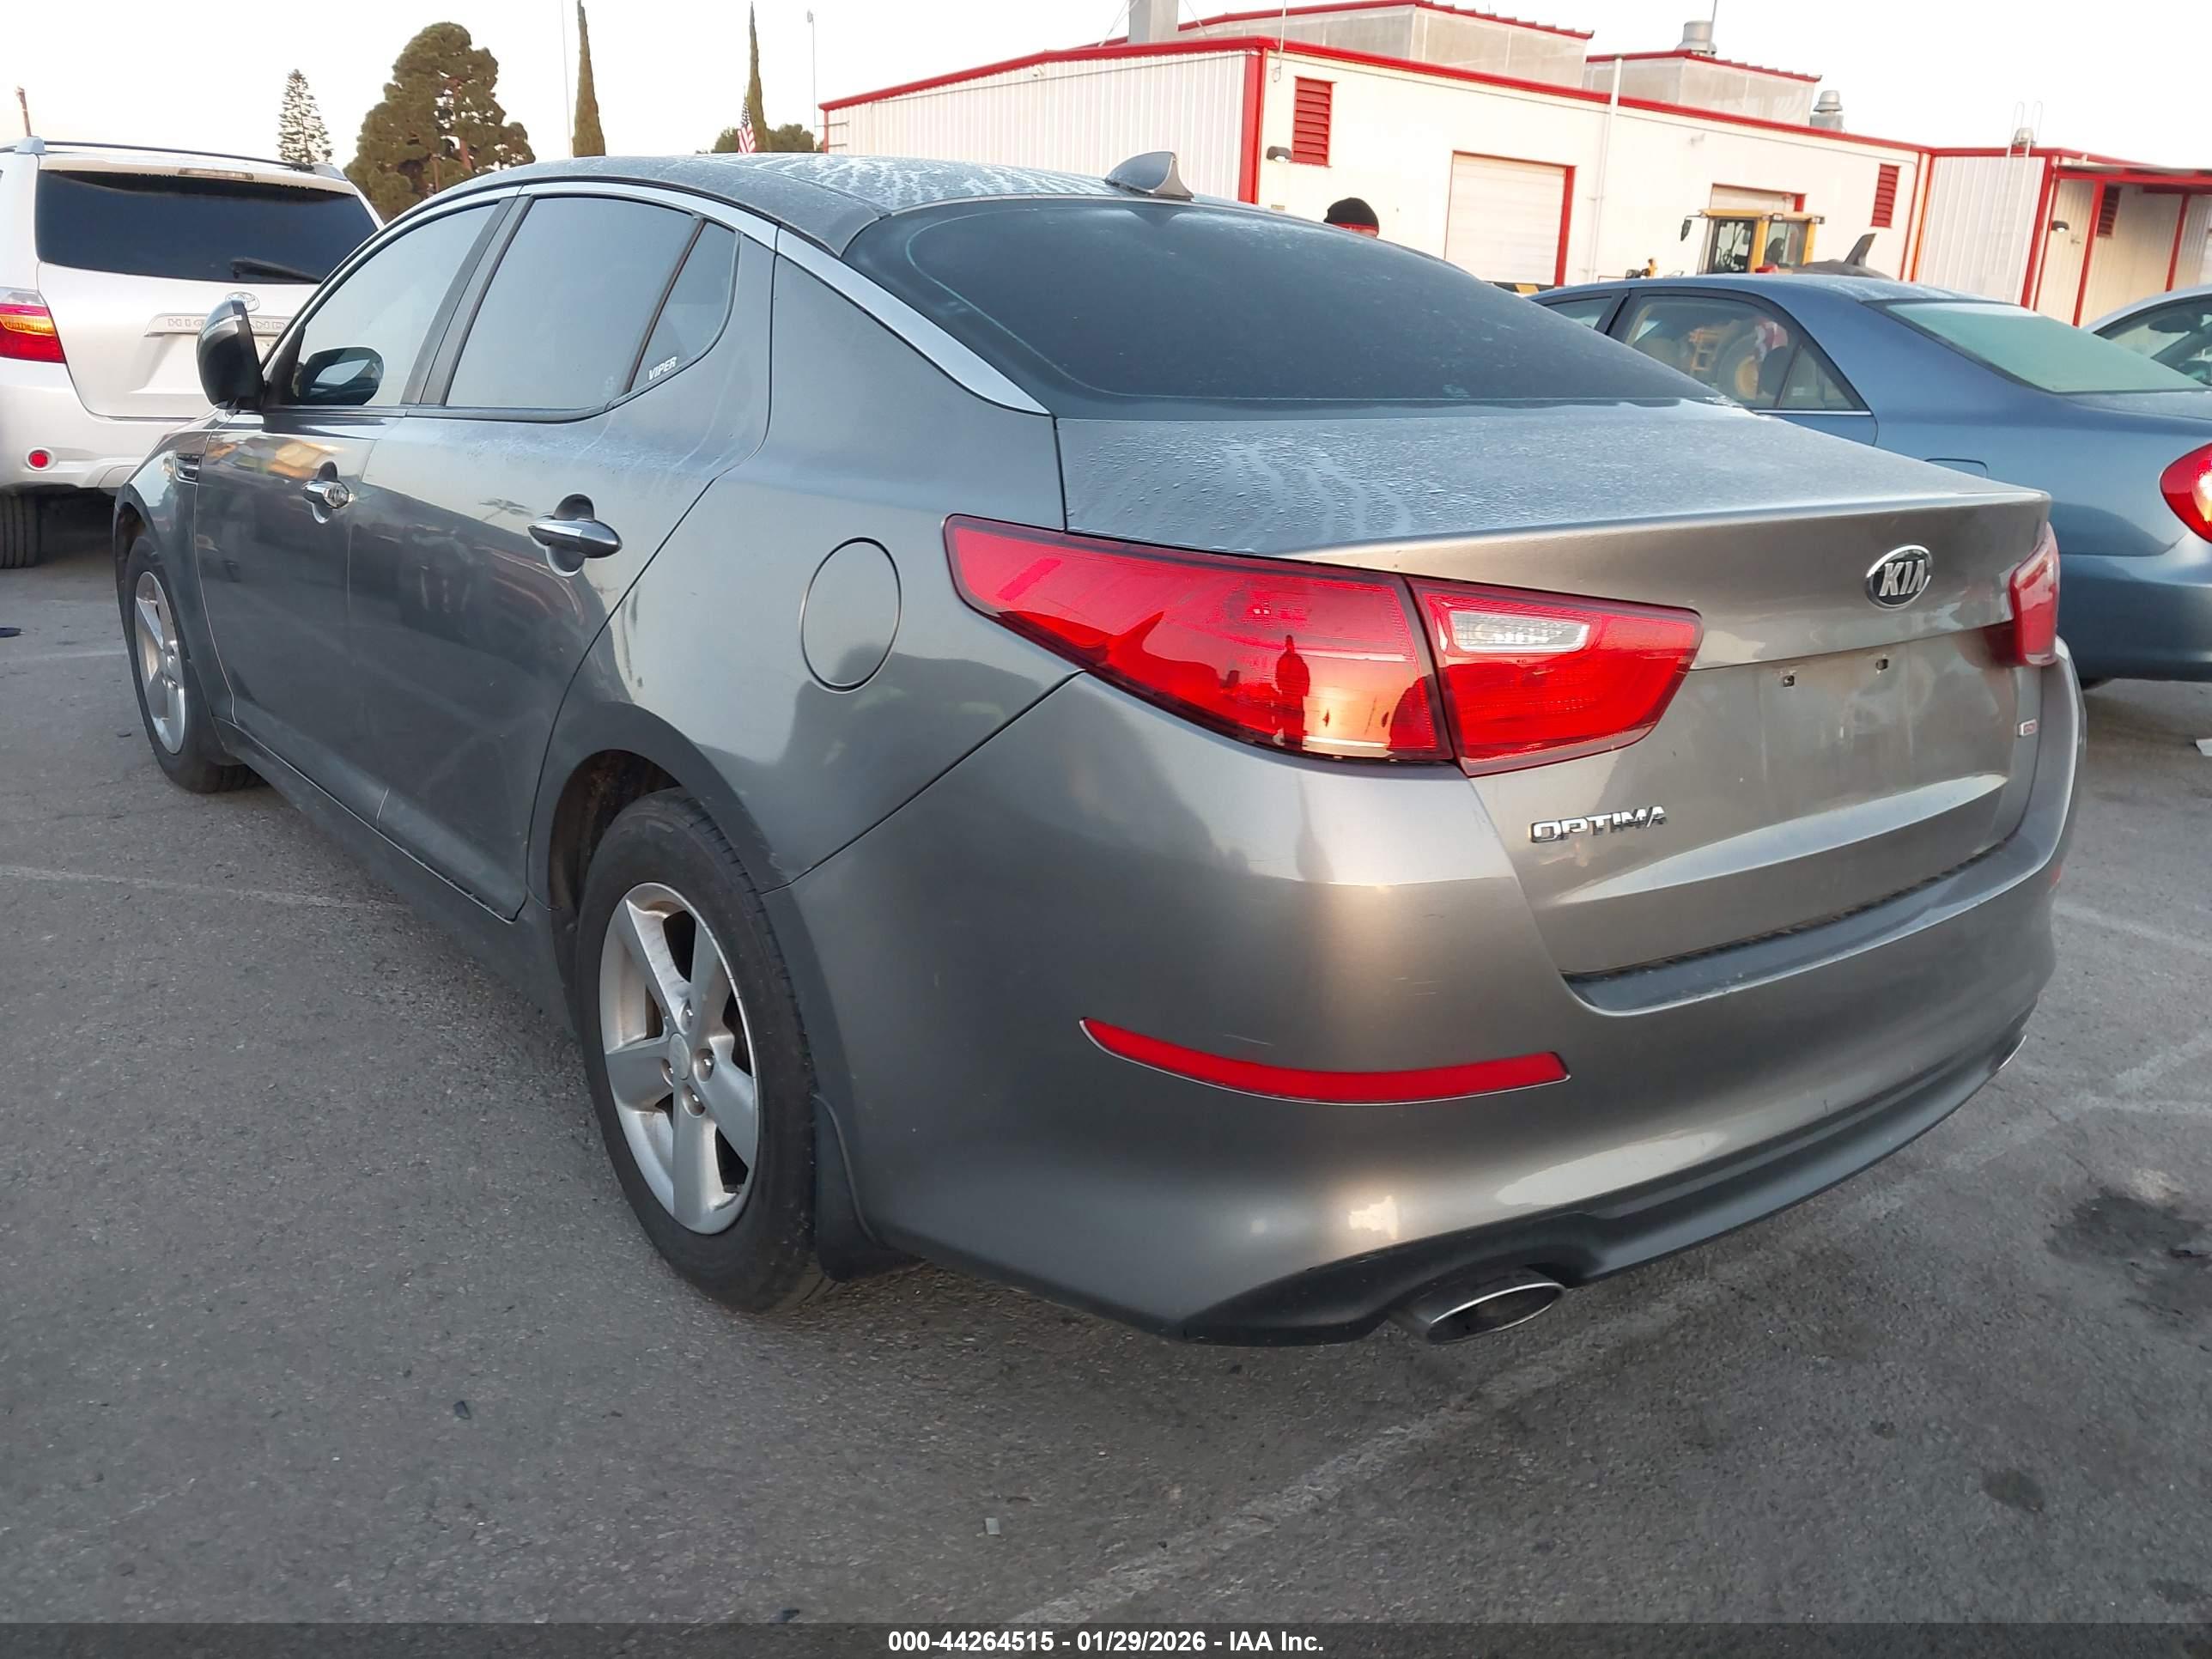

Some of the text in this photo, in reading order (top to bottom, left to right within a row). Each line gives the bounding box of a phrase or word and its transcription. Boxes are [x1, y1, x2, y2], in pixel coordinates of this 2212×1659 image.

[648, 356, 678, 380] VIPER
[1879, 559, 1925, 597] KIA
[1530, 805, 1667, 842] OPTIMA
